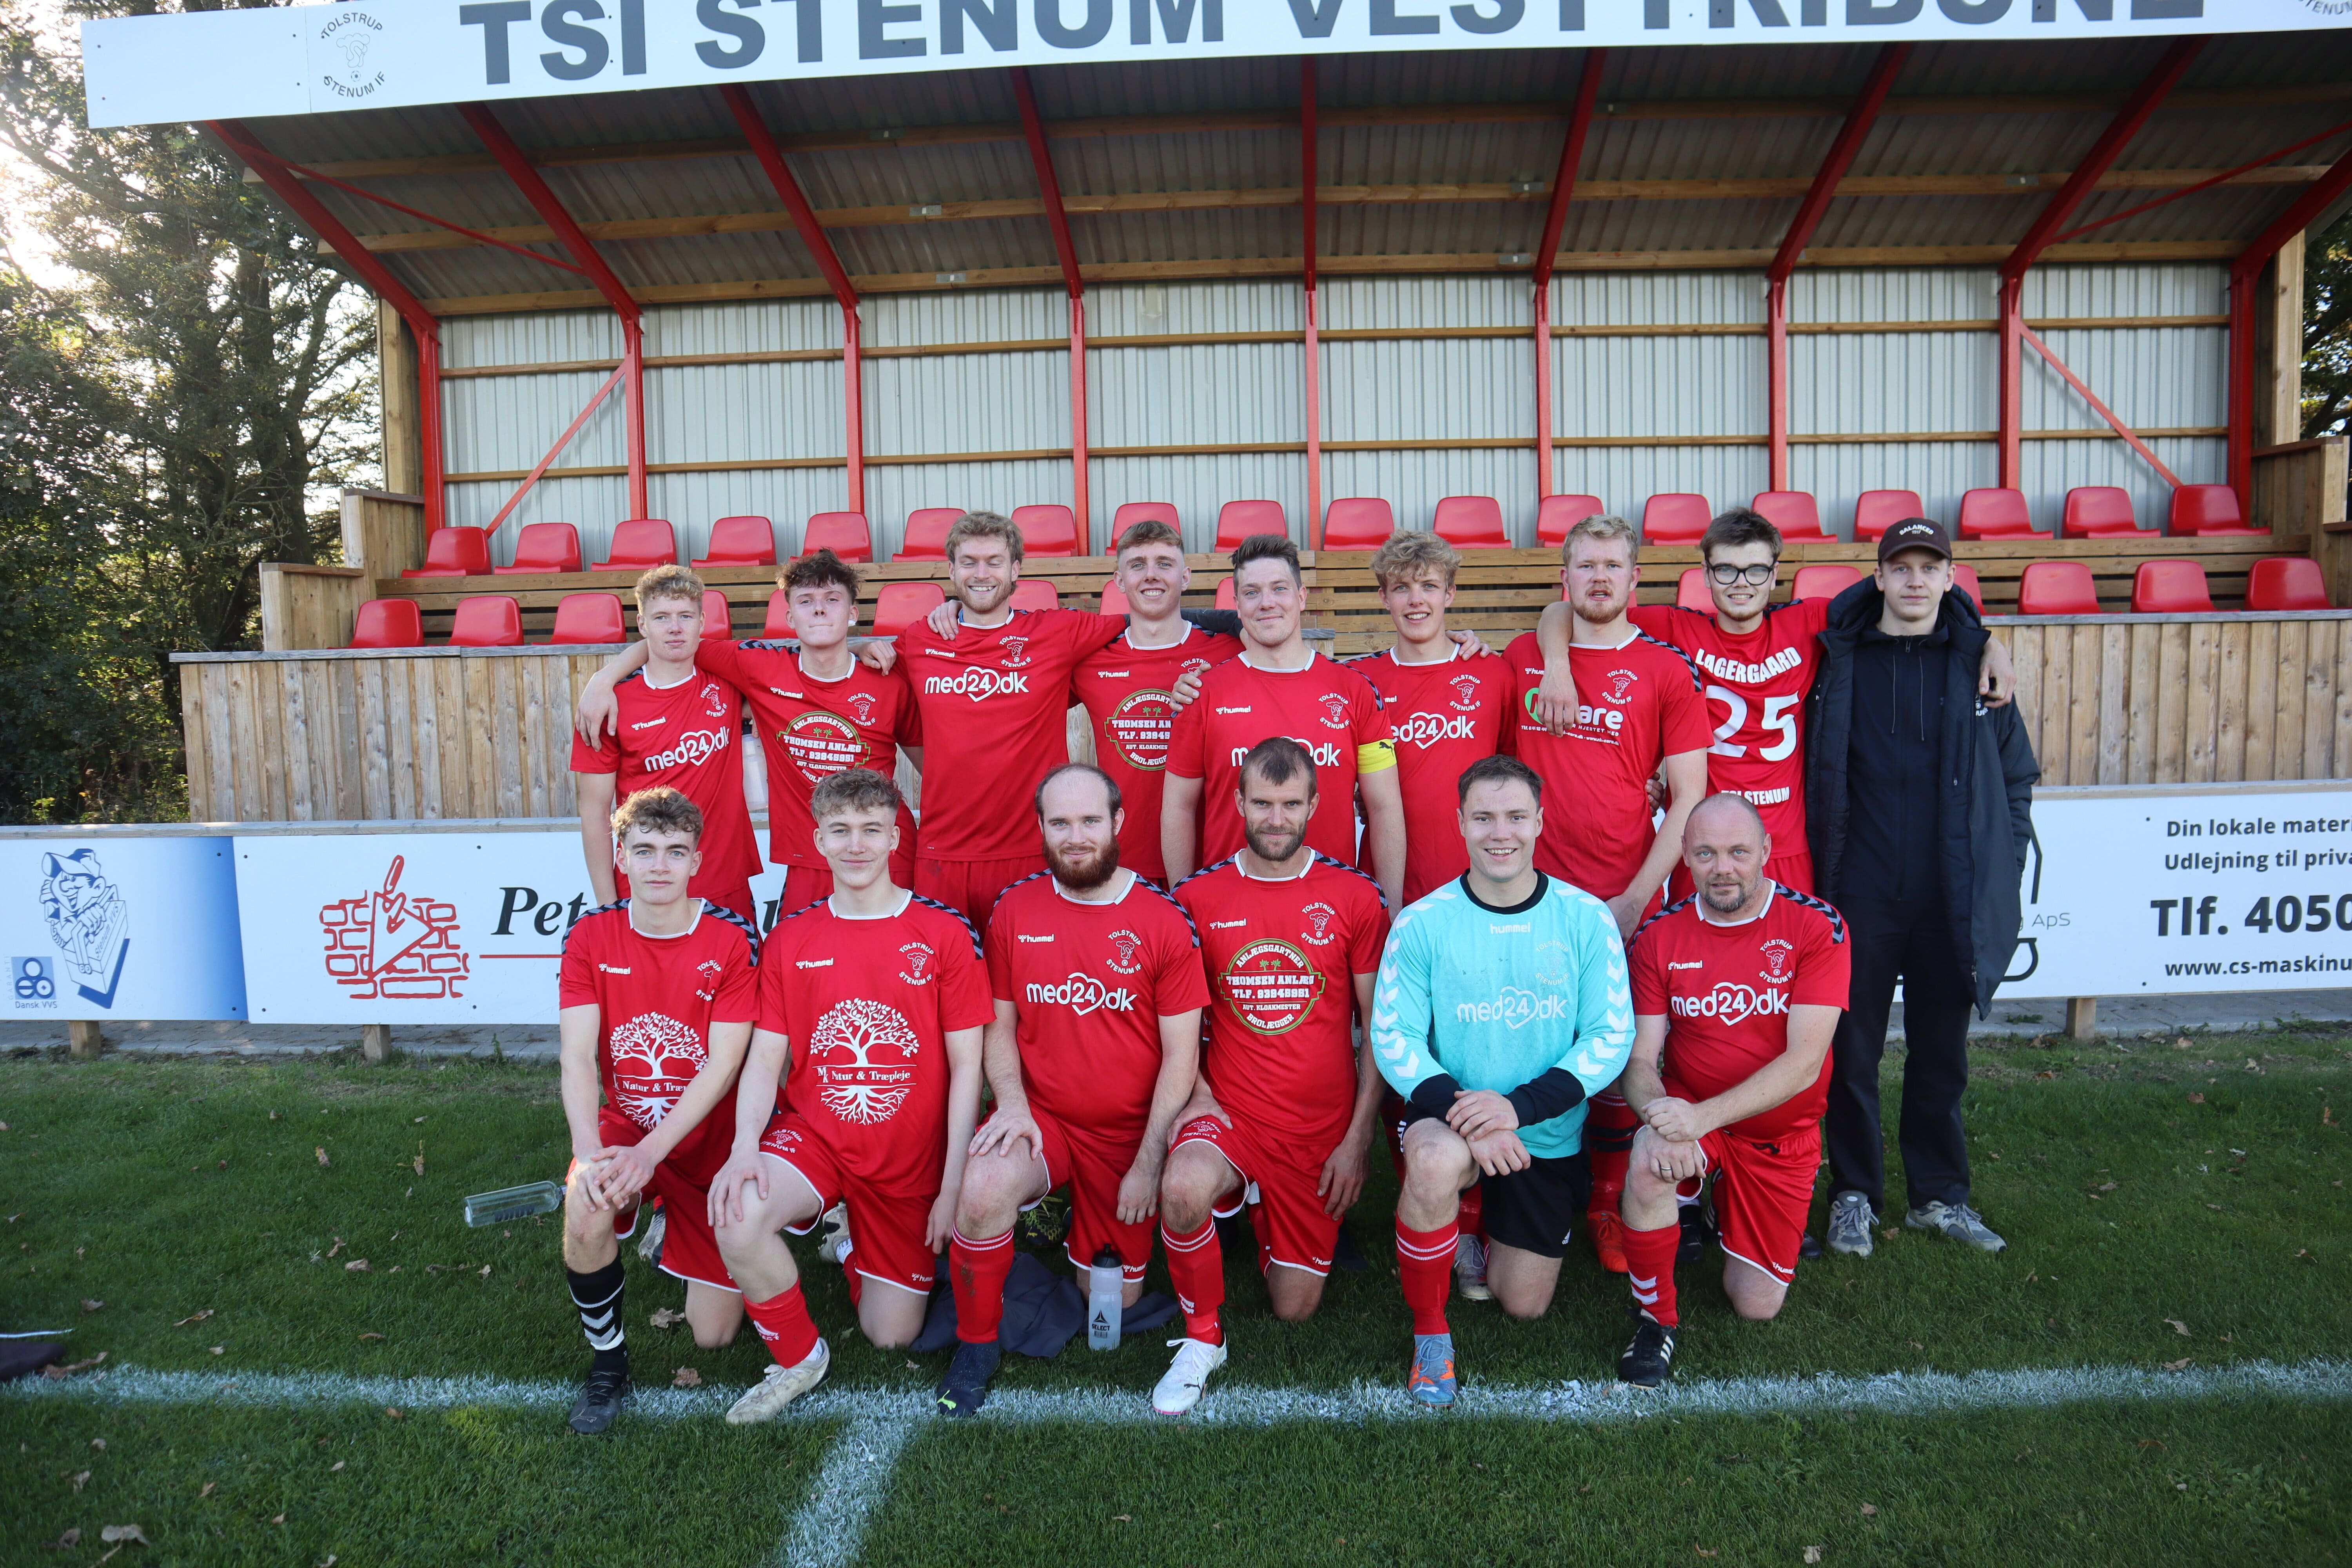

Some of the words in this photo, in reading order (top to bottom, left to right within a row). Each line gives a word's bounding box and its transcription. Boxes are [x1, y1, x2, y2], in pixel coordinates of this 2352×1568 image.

[321, 13, 383, 37] TOLSTRUP
[459, 0, 646, 85] TSI
[324, 75, 374, 97] STENUM
[375, 71, 385, 85] IF
[999, 635, 1029, 646] TOLSTRUP
[931, 649, 955, 658] hummel
[1001, 659, 1025, 668] STENUM
[1025, 656, 1032, 665] IF
[1181, 658, 1211, 668] TOLSTR
[1695, 646, 1802, 684] LAGERGAARD
[1449, 674, 1481, 686] TOLSTRUP
[1607, 669, 1638, 681] TOLSTRUP
[924, 671, 1030, 694] med24.dk
[779, 689, 803, 699] hummel
[847, 693, 876, 703] TOLSTRUP
[1318, 693, 1349, 705] TOLSTRUP
[1602, 691, 1626, 705] STENUM
[1122, 694, 1171, 713] ANLÆGSGART
[1450, 701, 1476, 711] STENUM
[1475, 701, 1481, 709] IF
[640, 716, 666, 729] hummel
[1111, 719, 1156, 728] THOMSEN
[1319, 717, 1345, 729] STENUM
[1580, 705, 1624, 730] are
[1705, 684, 1800, 761] 25
[793, 716, 854, 739] ANLÆGSGARTNER
[1390, 715, 1476, 743] ed24.dk
[1118, 731, 1138, 739] TLF.
[783, 735, 827, 750] THOMSEN
[828, 742, 862, 753] ANLÆG
[789, 746, 808, 758] TLF.
[1129, 751, 1167, 765] BROLÆGG
[1744, 786, 1790, 805] STENUM
[2167, 820, 2202, 837] Din
[2209, 818, 2275, 836] lokale
[2165, 851, 2269, 874] Udlejning
[2275, 849, 2298, 867] til
[490, 887, 587, 935] Pet
[1301, 902, 1335, 916] TOLSTRUP
[2150, 896, 2229, 936] Tlf.
[1217, 918, 1246, 929] hummel
[1490, 922, 1531, 935] hummel
[2031, 913, 2070, 930] ApS
[95, 925, 111, 958] Stenum
[109, 902, 119, 924] VVS
[1027, 934, 1054, 943] hummel
[1108, 929, 1142, 946] TOLSTRUP
[1301, 932, 1328, 946] STENUM
[1329, 933, 1336, 944] IF
[898, 942, 934, 956] TOLSTRUP
[1536, 940, 1569, 953] TOLSTRUP
[1760, 938, 1793, 952] TOLSTRUP
[805, 957, 834, 968] hummel
[1236, 944, 1304, 969] ANLÆGSGARTNER
[696, 960, 721, 972] TOLSUP
[1106, 959, 1134, 974] STENUM
[1135, 963, 1142, 972] IF
[1674, 960, 1703, 969] hummel
[4, 956, 14, 1000] GARANTI
[898, 971, 926, 985] STENUM
[1226, 976, 1275, 985] THOMSEN
[1277, 975, 1314, 985] ANLÆG
[1535, 972, 1563, 985] STENUM
[1563, 972, 1570, 982] IF
[1759, 971, 1788, 984] STENUM
[1788, 970, 1794, 980] IF
[1026, 980, 1138, 1011] med24.dk
[1232, 989, 1255, 999] TLF.
[1456, 994, 1568, 1023] med24.dk
[1671, 988, 1790, 1017] med24.dk
[1246, 1013, 1294, 1029] BROLÆGGER
[831, 1071, 853, 1080] Natur
[856, 1071, 866, 1080] &
[869, 1070, 911, 1083] Træpleje
[622, 1080, 649, 1092] Natur
[652, 1083, 661, 1092] &
